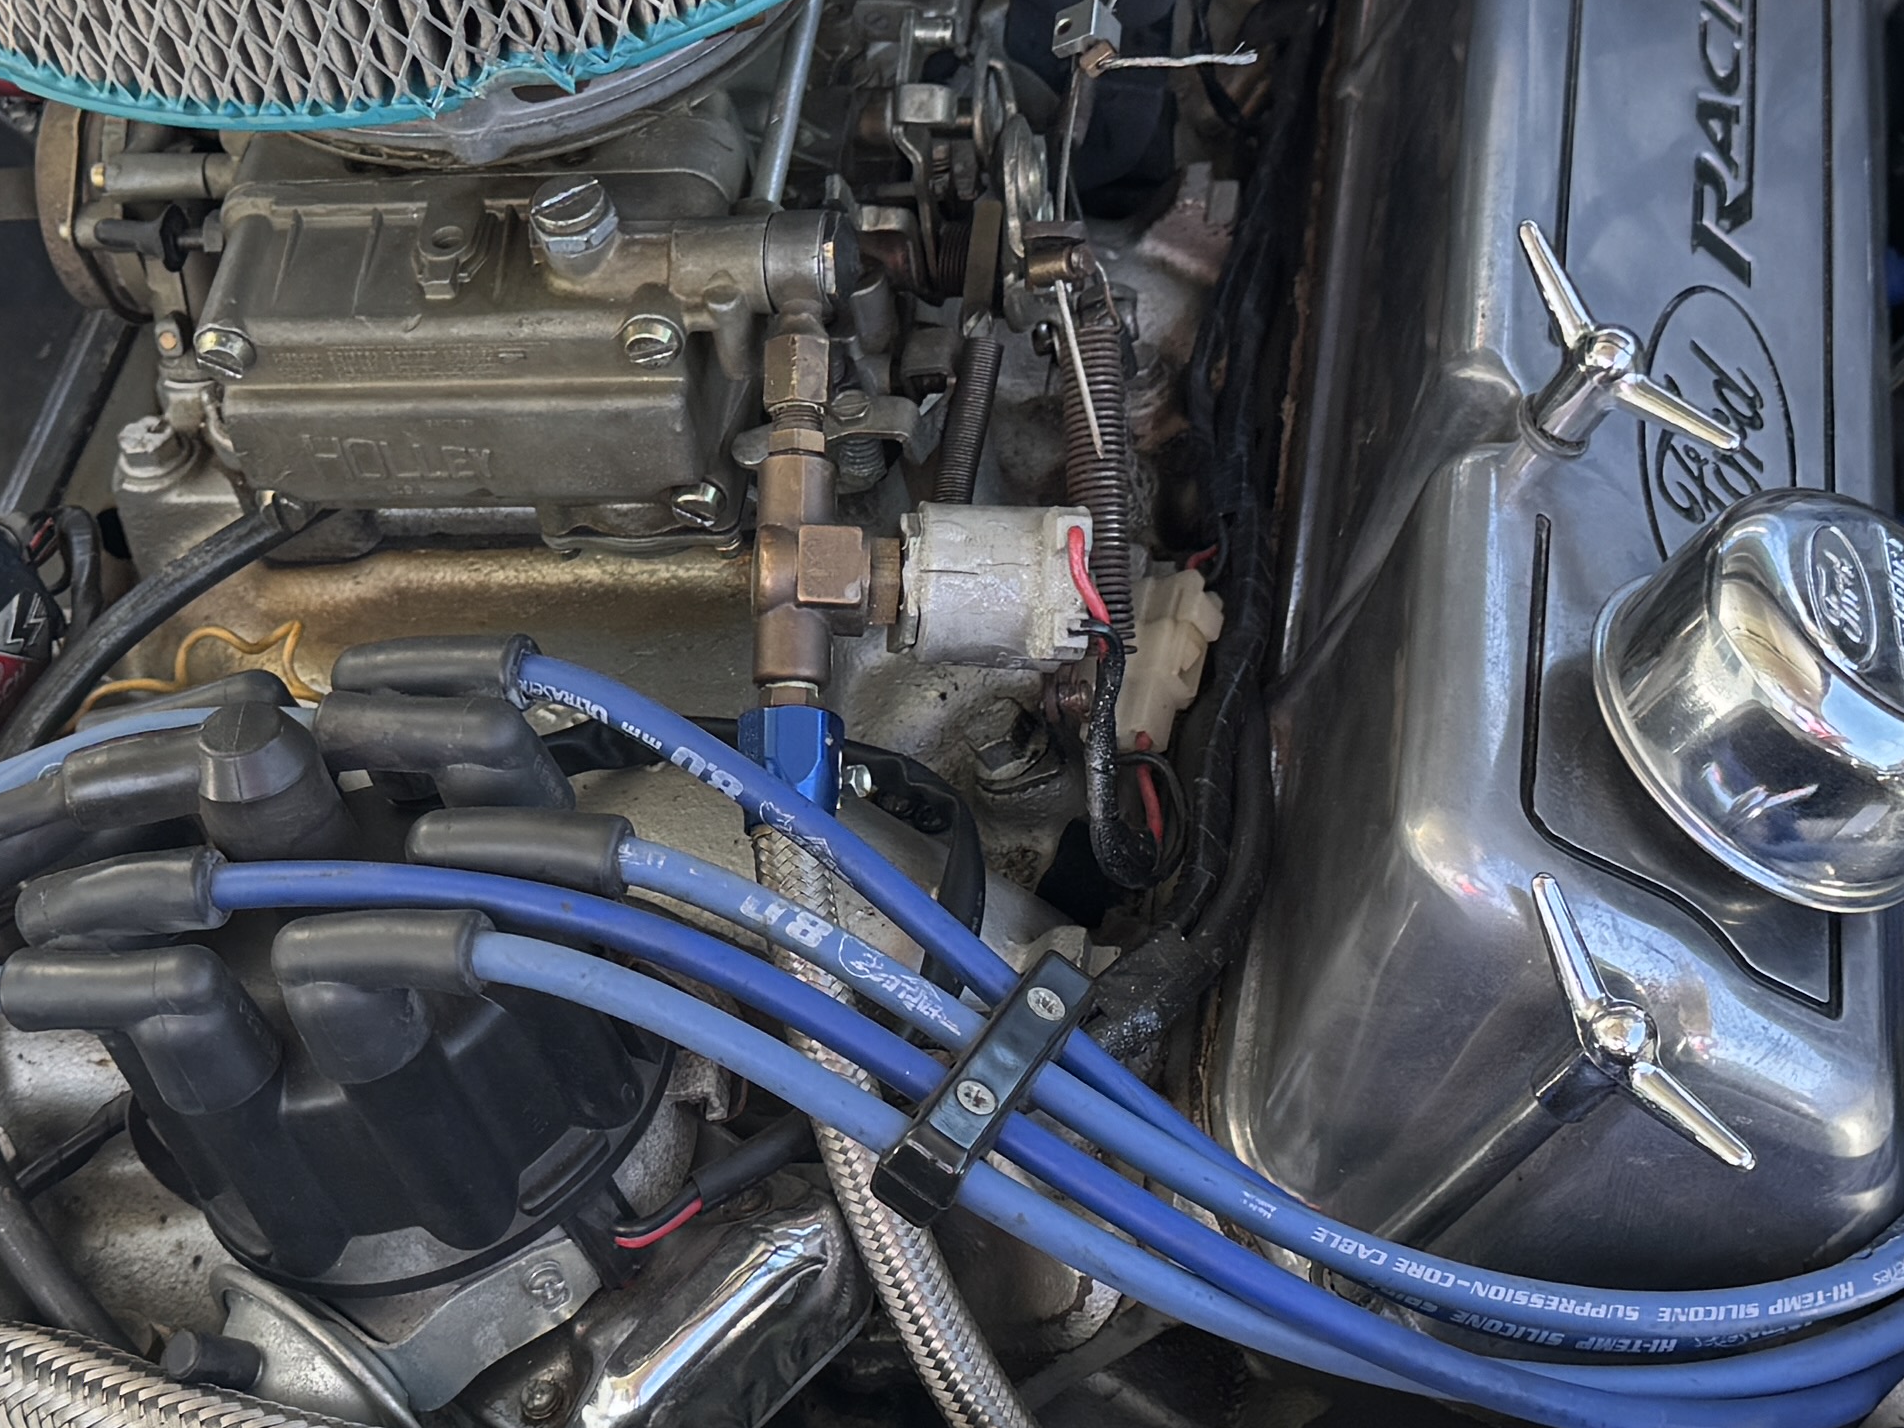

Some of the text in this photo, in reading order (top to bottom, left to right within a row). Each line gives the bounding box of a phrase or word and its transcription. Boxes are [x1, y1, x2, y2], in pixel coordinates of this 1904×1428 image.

[301, 434, 492, 480] HOLLEY
[1309, 1226, 1389, 1266] CABLE
[1392, 1256, 1641, 1321] SUPPRESSION-CORE
[1767, 1280, 1855, 1317] HI-TEMP
[1449, 1309, 1678, 1354] HI-TEMP SILICONE
[1656, 1302, 1760, 1323] SILICONE
